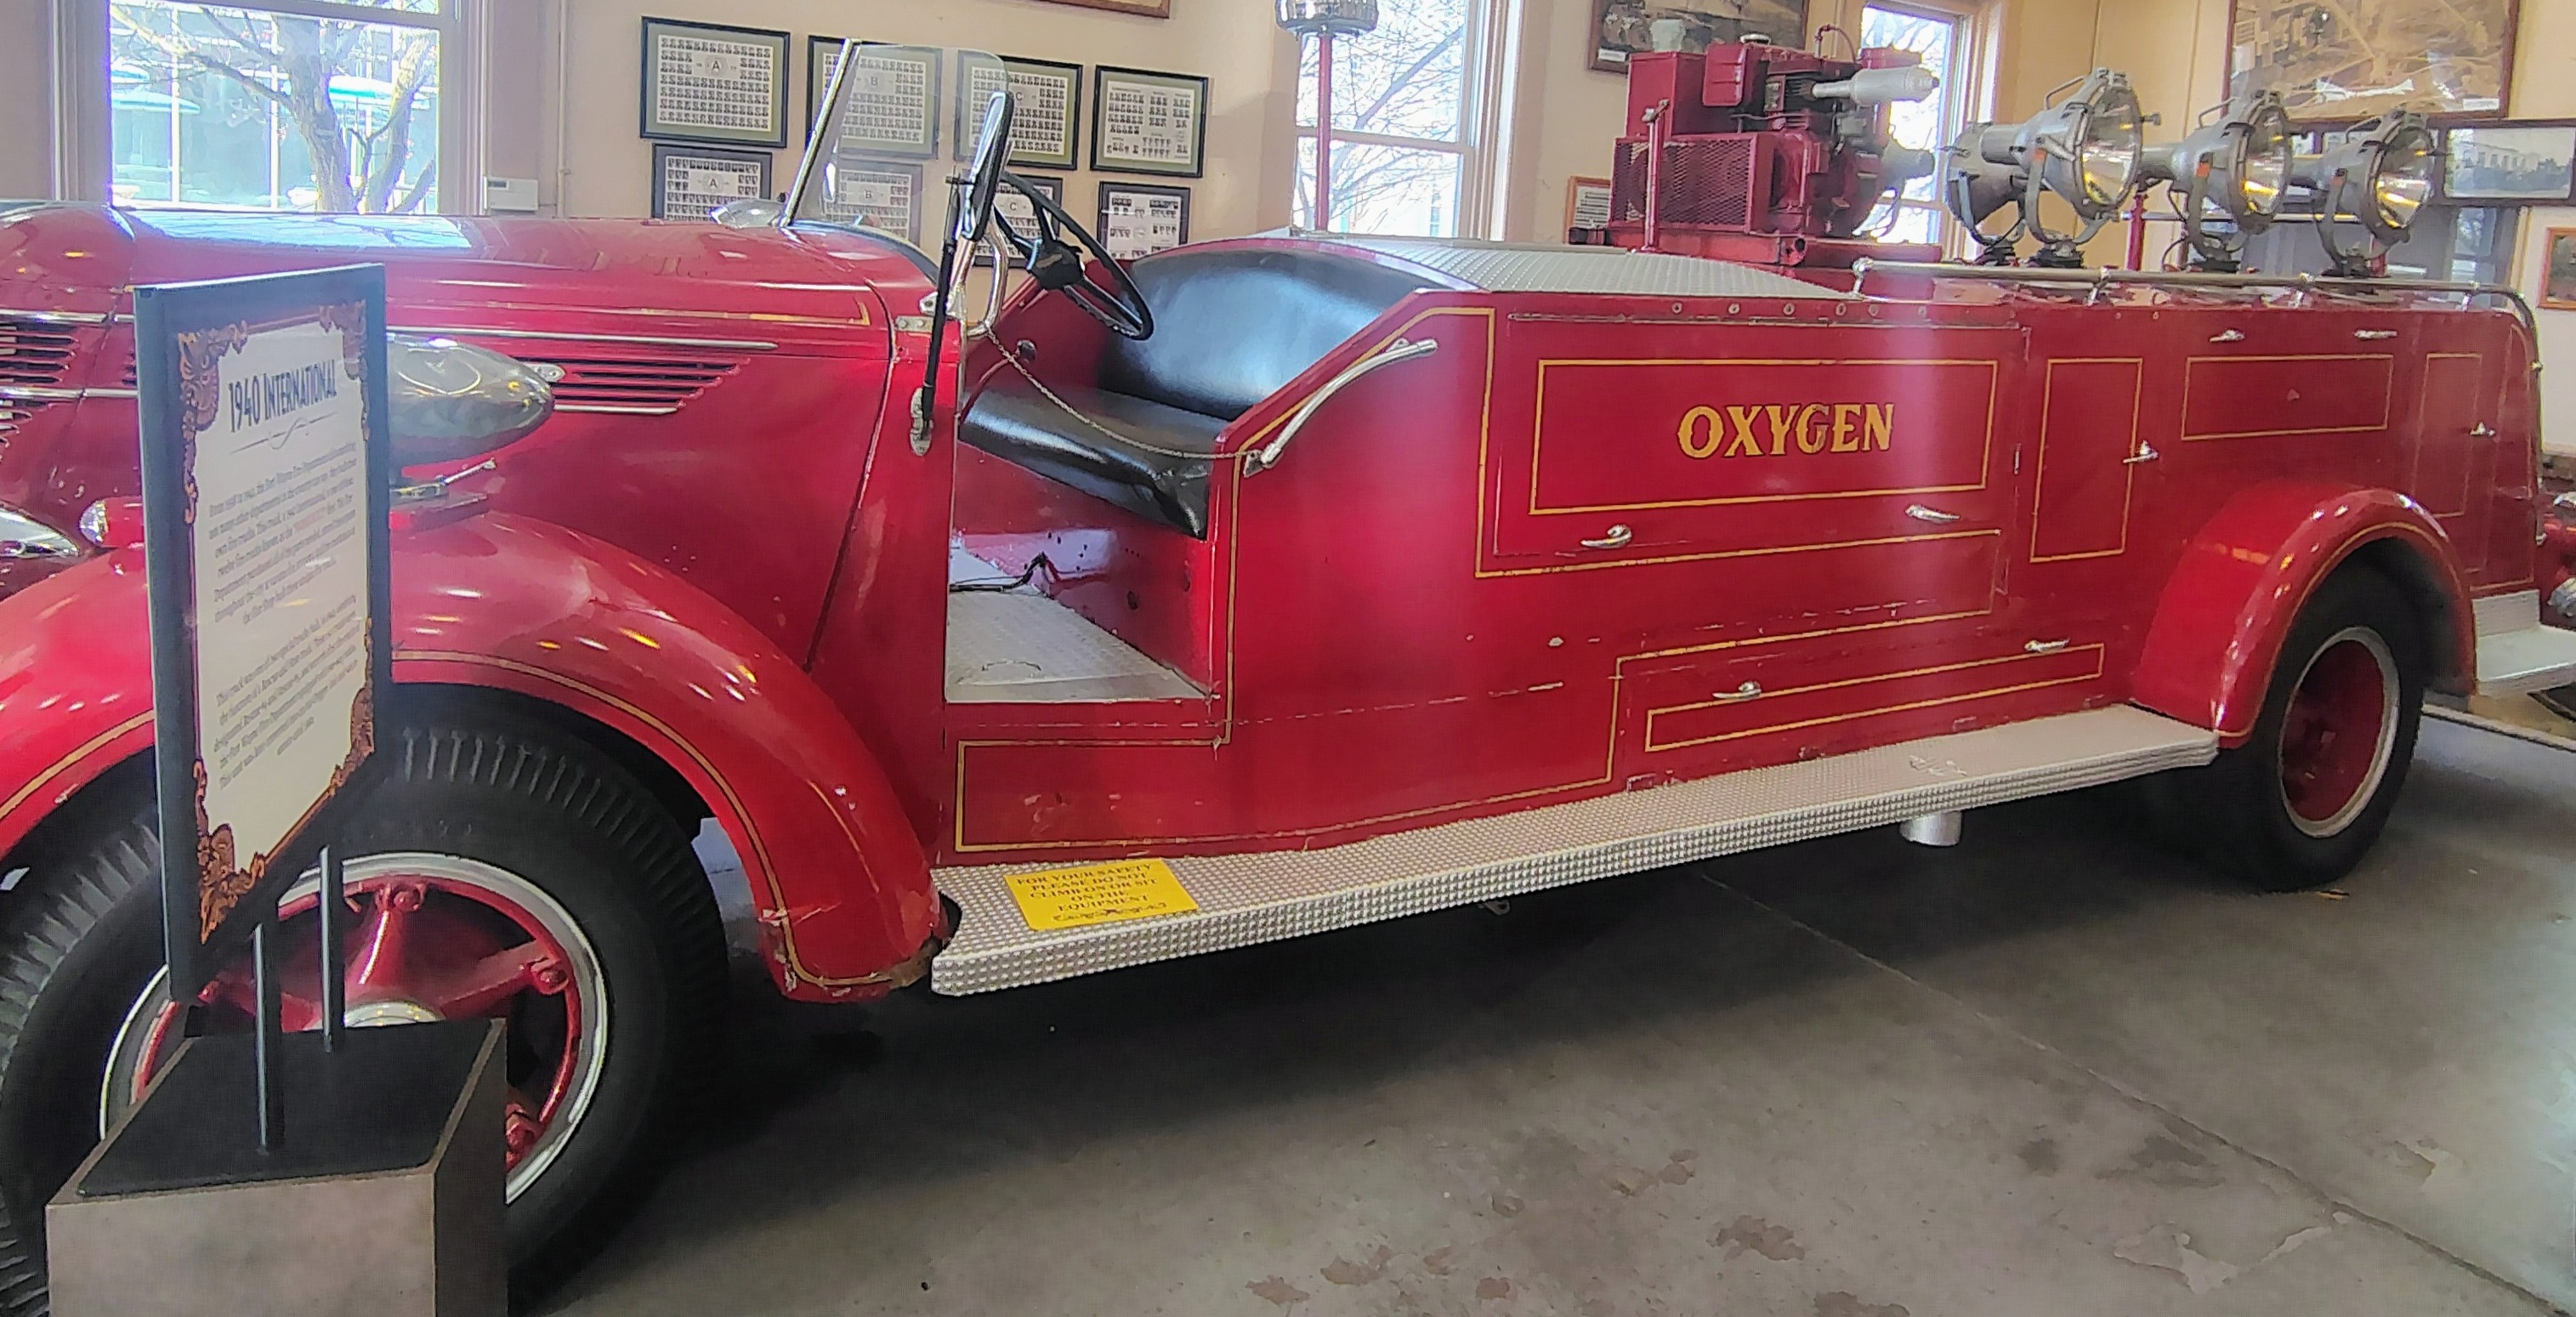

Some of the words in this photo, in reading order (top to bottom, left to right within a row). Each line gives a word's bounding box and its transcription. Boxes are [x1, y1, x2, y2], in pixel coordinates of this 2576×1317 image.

[228, 375, 260, 433] 1940
[263, 359, 337, 421] INTERNATIONAL
[1677, 402, 1895, 459] OXYGEN
[1018, 876, 1047, 885] FOR
[1052, 871, 1094, 882] YOUR
[1097, 863, 1152, 875] SAFETY
[1031, 879, 1089, 891] PLEASE
[1092, 877, 1114, 885] DO
[1117, 872, 1148, 882] NOT
[1030, 888, 1081, 899] CLIMB
[1085, 884, 1106, 893] ON
[1110, 882, 1131, 890] OR
[1070, 893, 1093, 902] ON
[1099, 889, 1129, 899] THE
[1058, 894, 1149, 911] EQUIPMENT
